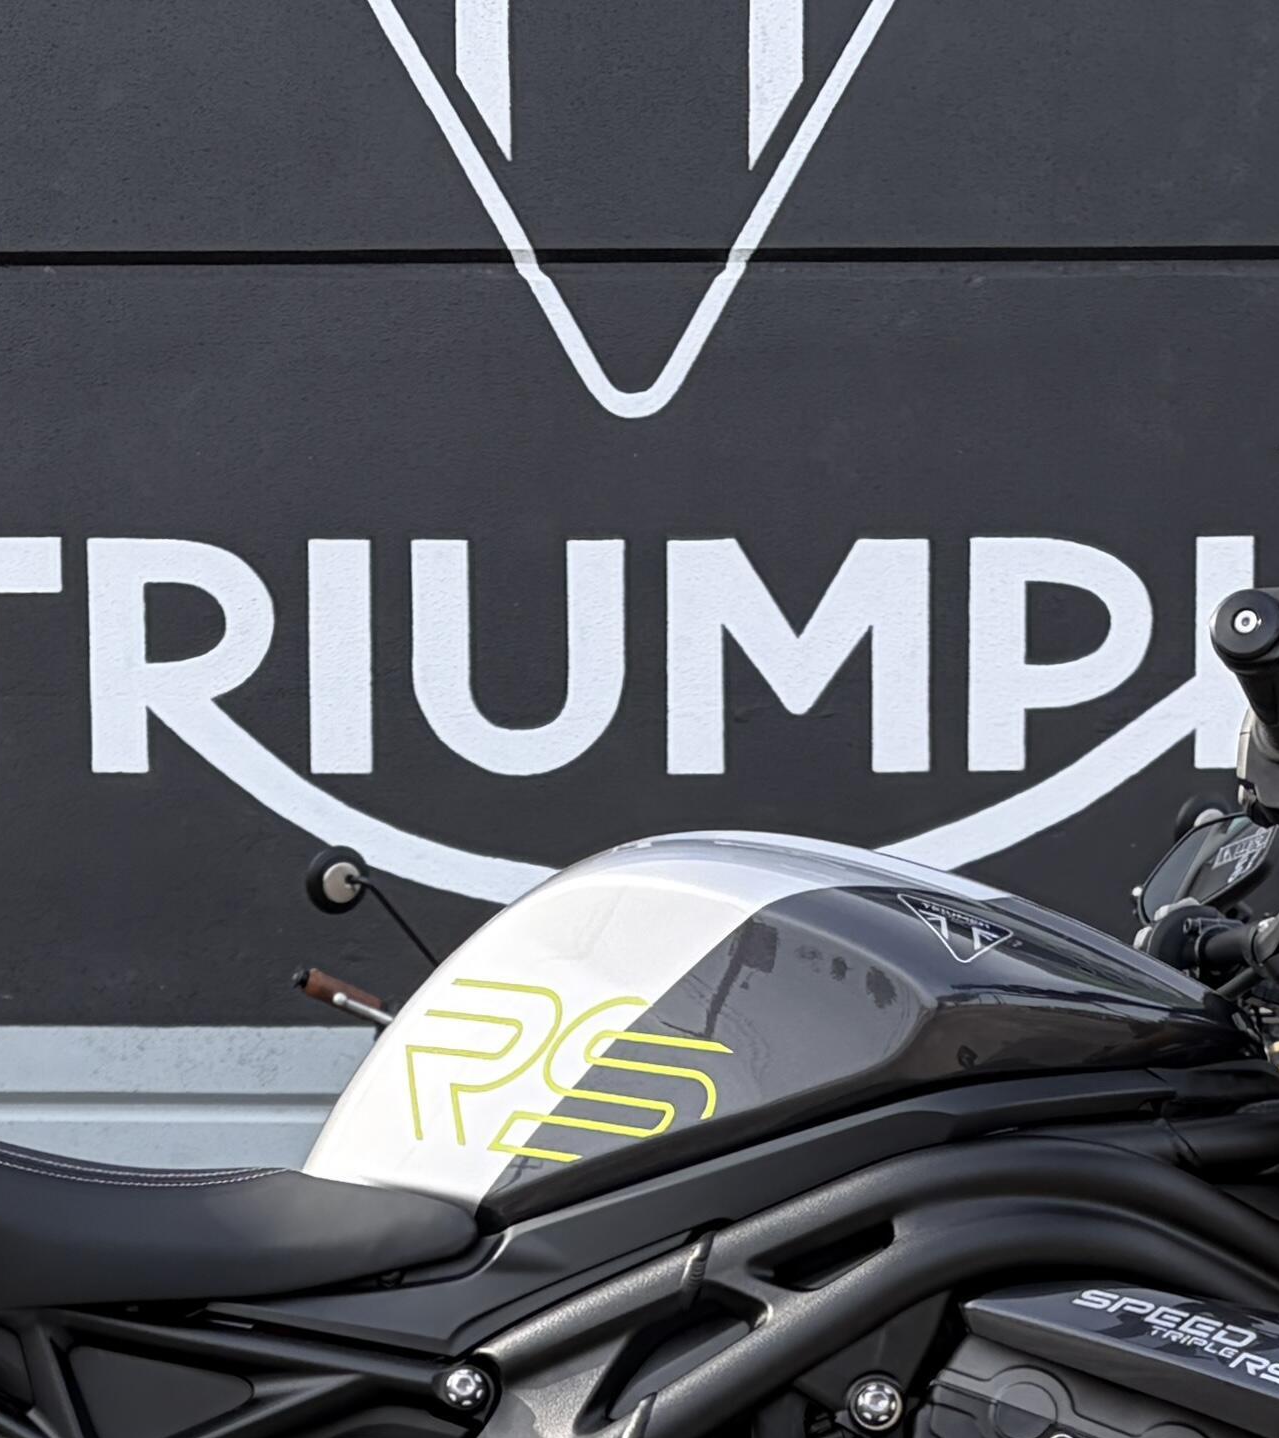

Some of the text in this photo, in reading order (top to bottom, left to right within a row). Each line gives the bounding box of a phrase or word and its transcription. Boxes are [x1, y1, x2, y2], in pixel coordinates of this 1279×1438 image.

[405, 978, 734, 1163] RS
[1072, 1289, 1258, 1349] SPEED
[1150, 1326, 1237, 1360] TRIPLE
